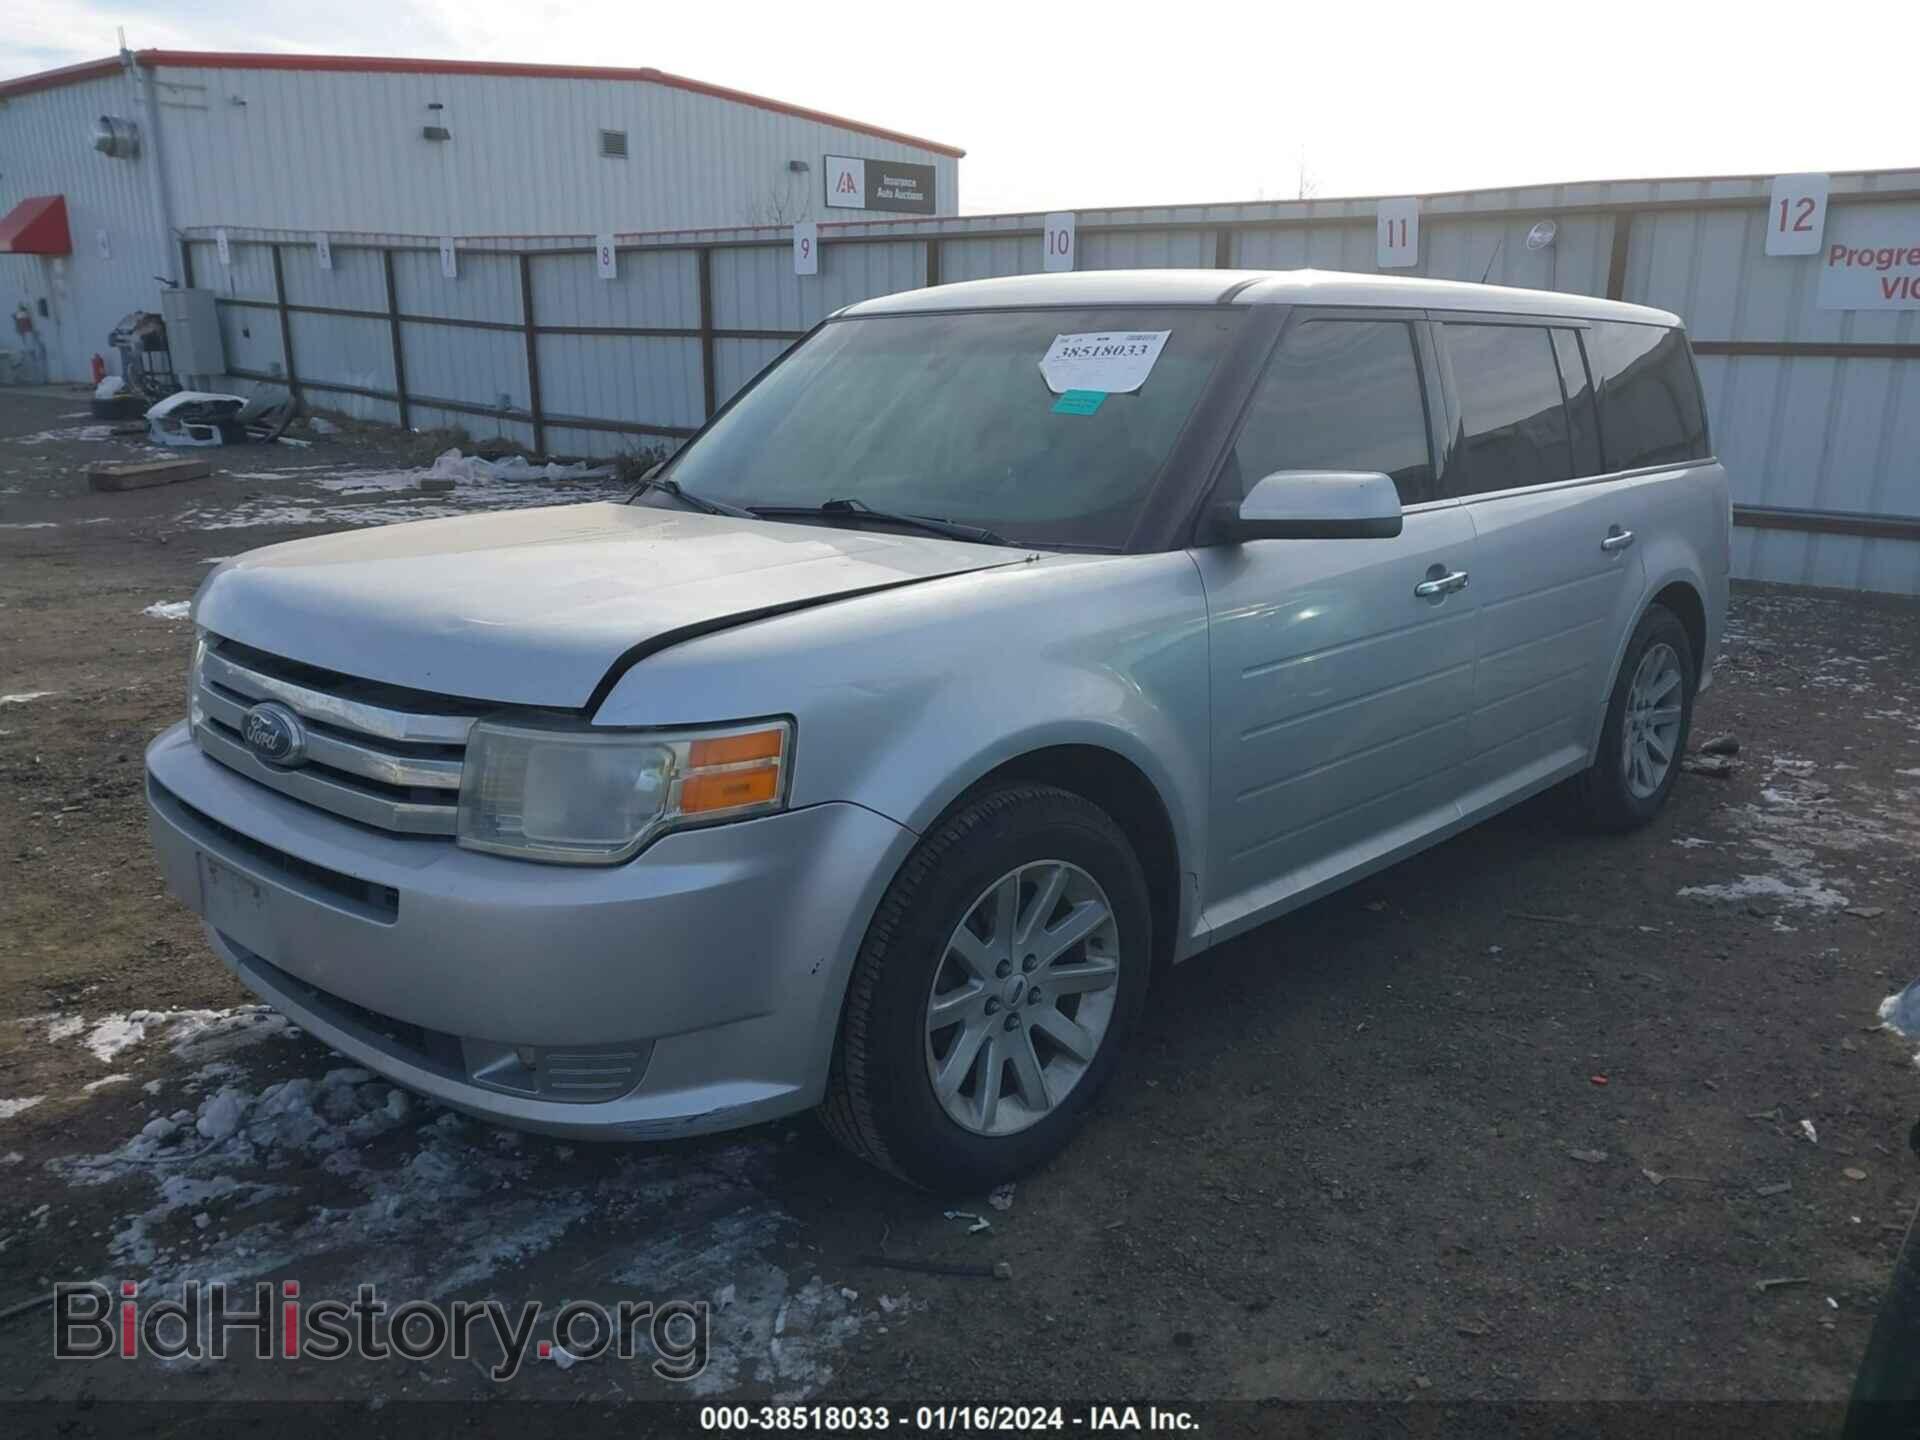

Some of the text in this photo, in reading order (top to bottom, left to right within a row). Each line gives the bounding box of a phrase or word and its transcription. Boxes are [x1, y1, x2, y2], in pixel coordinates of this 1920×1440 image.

[883, 174, 917, 188] Insurance
[876, 186, 924, 201] Auto Auctions
[1779, 197, 1816, 232] 12
[1049, 230, 1069, 255] 10
[1386, 218, 1408, 248] 11
[602, 246, 610, 266] 8
[801, 238, 810, 259] 9
[1055, 344, 1149, 359] 38518033
[247, 713, 281, 750] Ford
